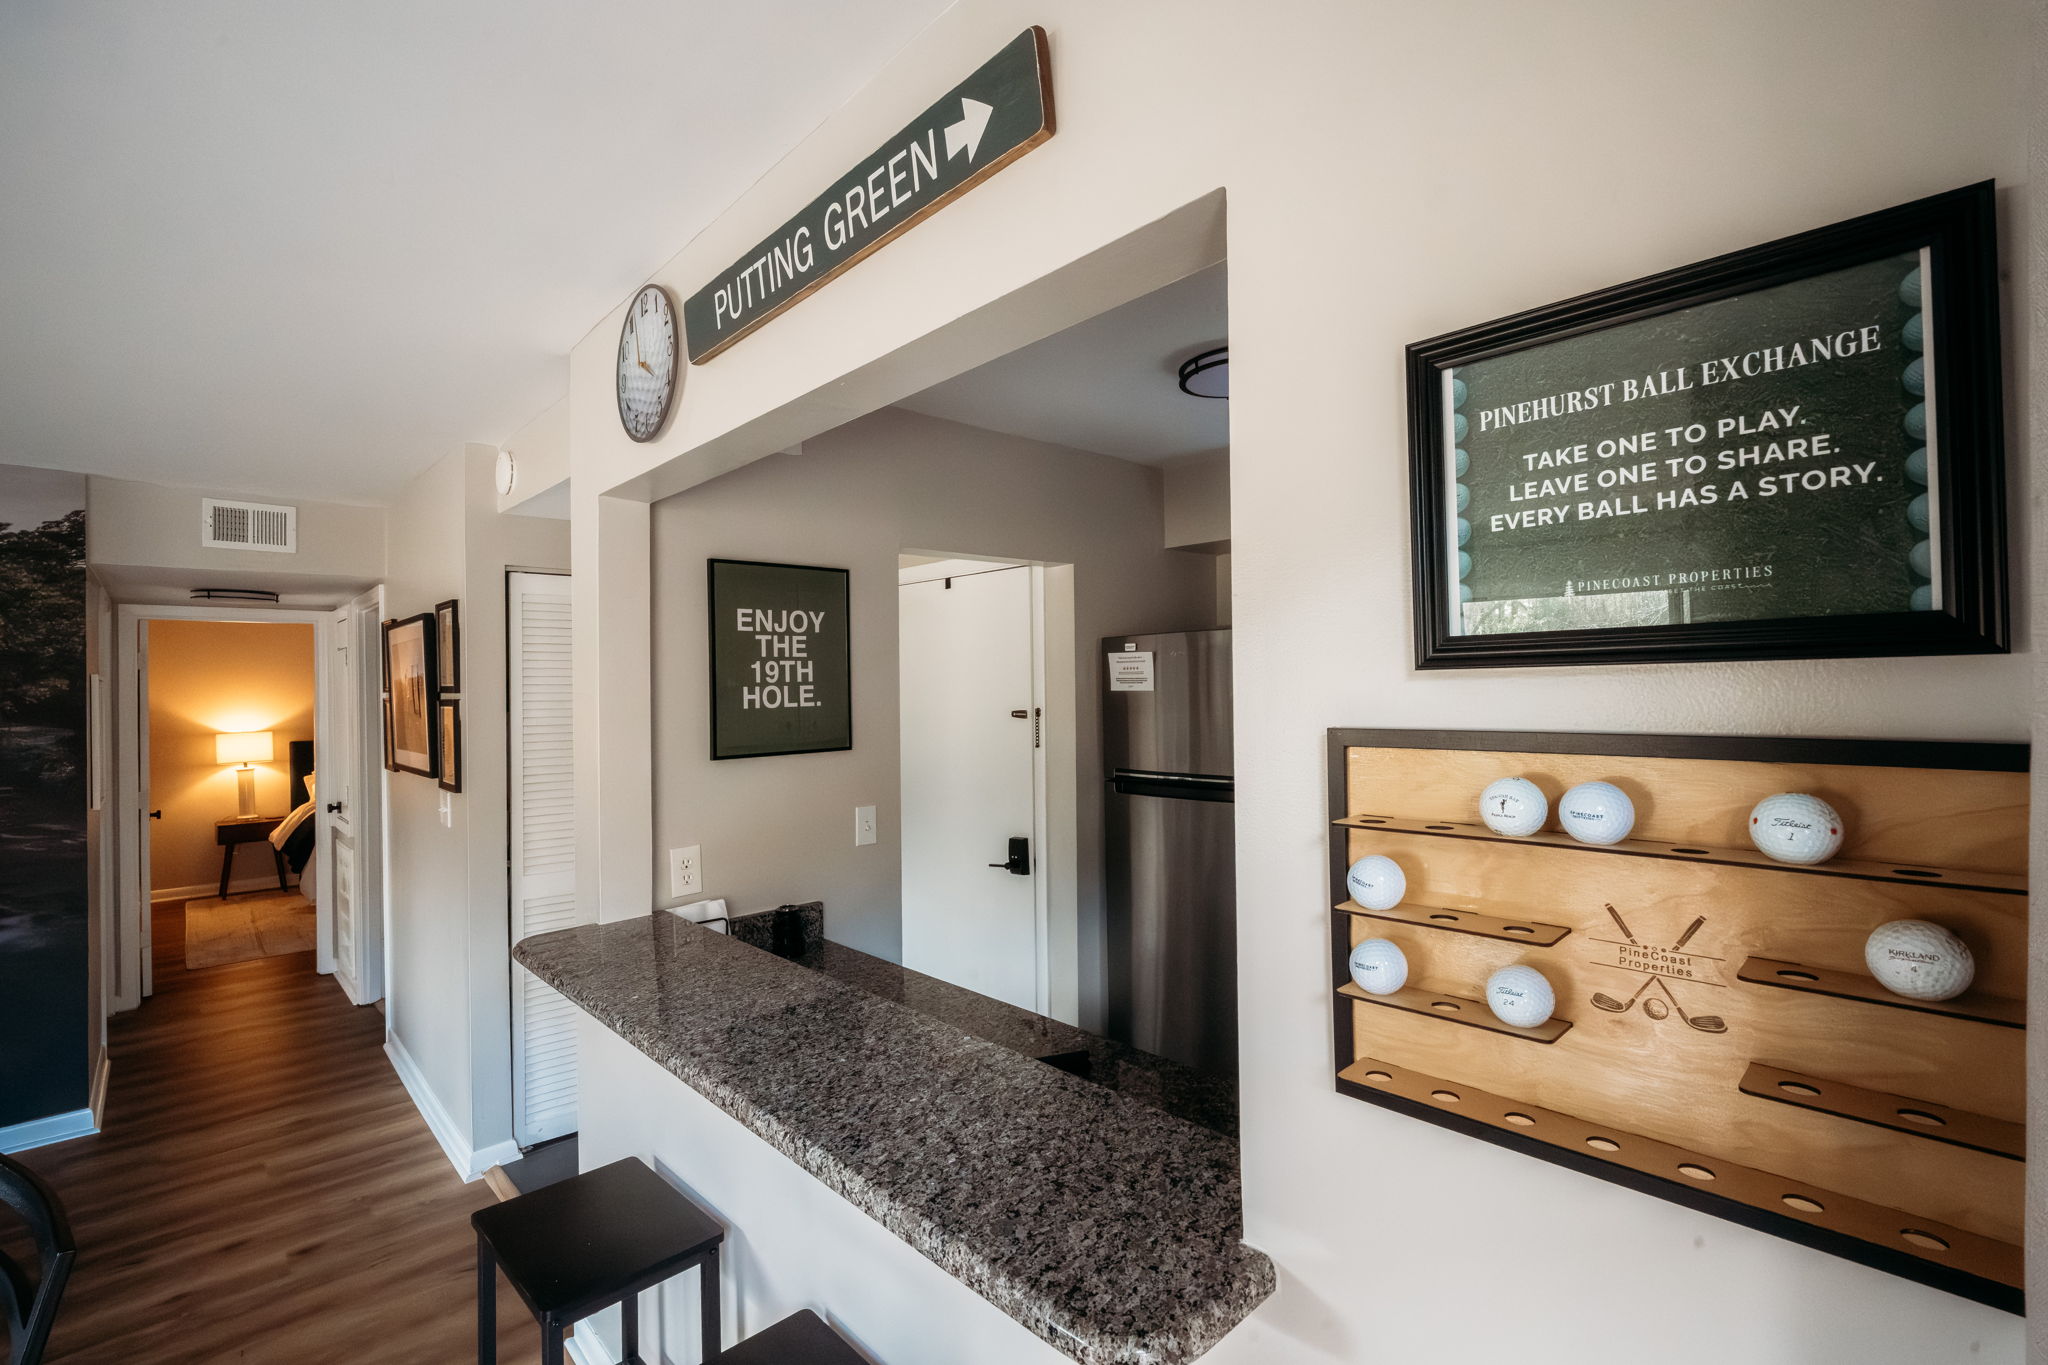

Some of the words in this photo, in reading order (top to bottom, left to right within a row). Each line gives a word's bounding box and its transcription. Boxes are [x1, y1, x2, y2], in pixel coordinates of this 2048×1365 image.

[713, 226, 814, 330] PUTTING
[823, 128, 938, 250] GREEN
[1479, 383, 1616, 432] PINEHURST
[1623, 367, 1694, 403] BALL
[1701, 325, 1881, 386] EXCHANGE
[1523, 444, 1588, 472] TAKE
[1597, 431, 1657, 458] ONE
[1665, 424, 1706, 448] TO
[1718, 405, 1806, 438] PLAY.
[1510, 473, 1589, 502] LEAVE
[1597, 462, 1657, 488] ONE
[1666, 456, 1707, 479] TO
[1718, 434, 1840, 468] SHARE.
[1490, 505, 1571, 532] EVERY
[1578, 497, 1648, 521] BALL
[1657, 485, 1718, 510] HAS
[1727, 480, 1749, 501] A
[1758, 462, 1883, 498] STORY.
[1578, 574, 1660, 592] PINECOAST
[1669, 565, 1773, 584] PROPERTIES
[736, 608, 825, 633] ENJOY
[755, 635, 808, 657] THE
[751, 660, 813, 683] 19TH
[743, 685, 821, 709] HOLE.
[1771, 817, 1812, 830] Titleist
[1619, 946, 1692, 966] PineCoast
[1888, 948, 1941, 961] KIRKLAND
[1618, 956, 1693, 978] Properties
